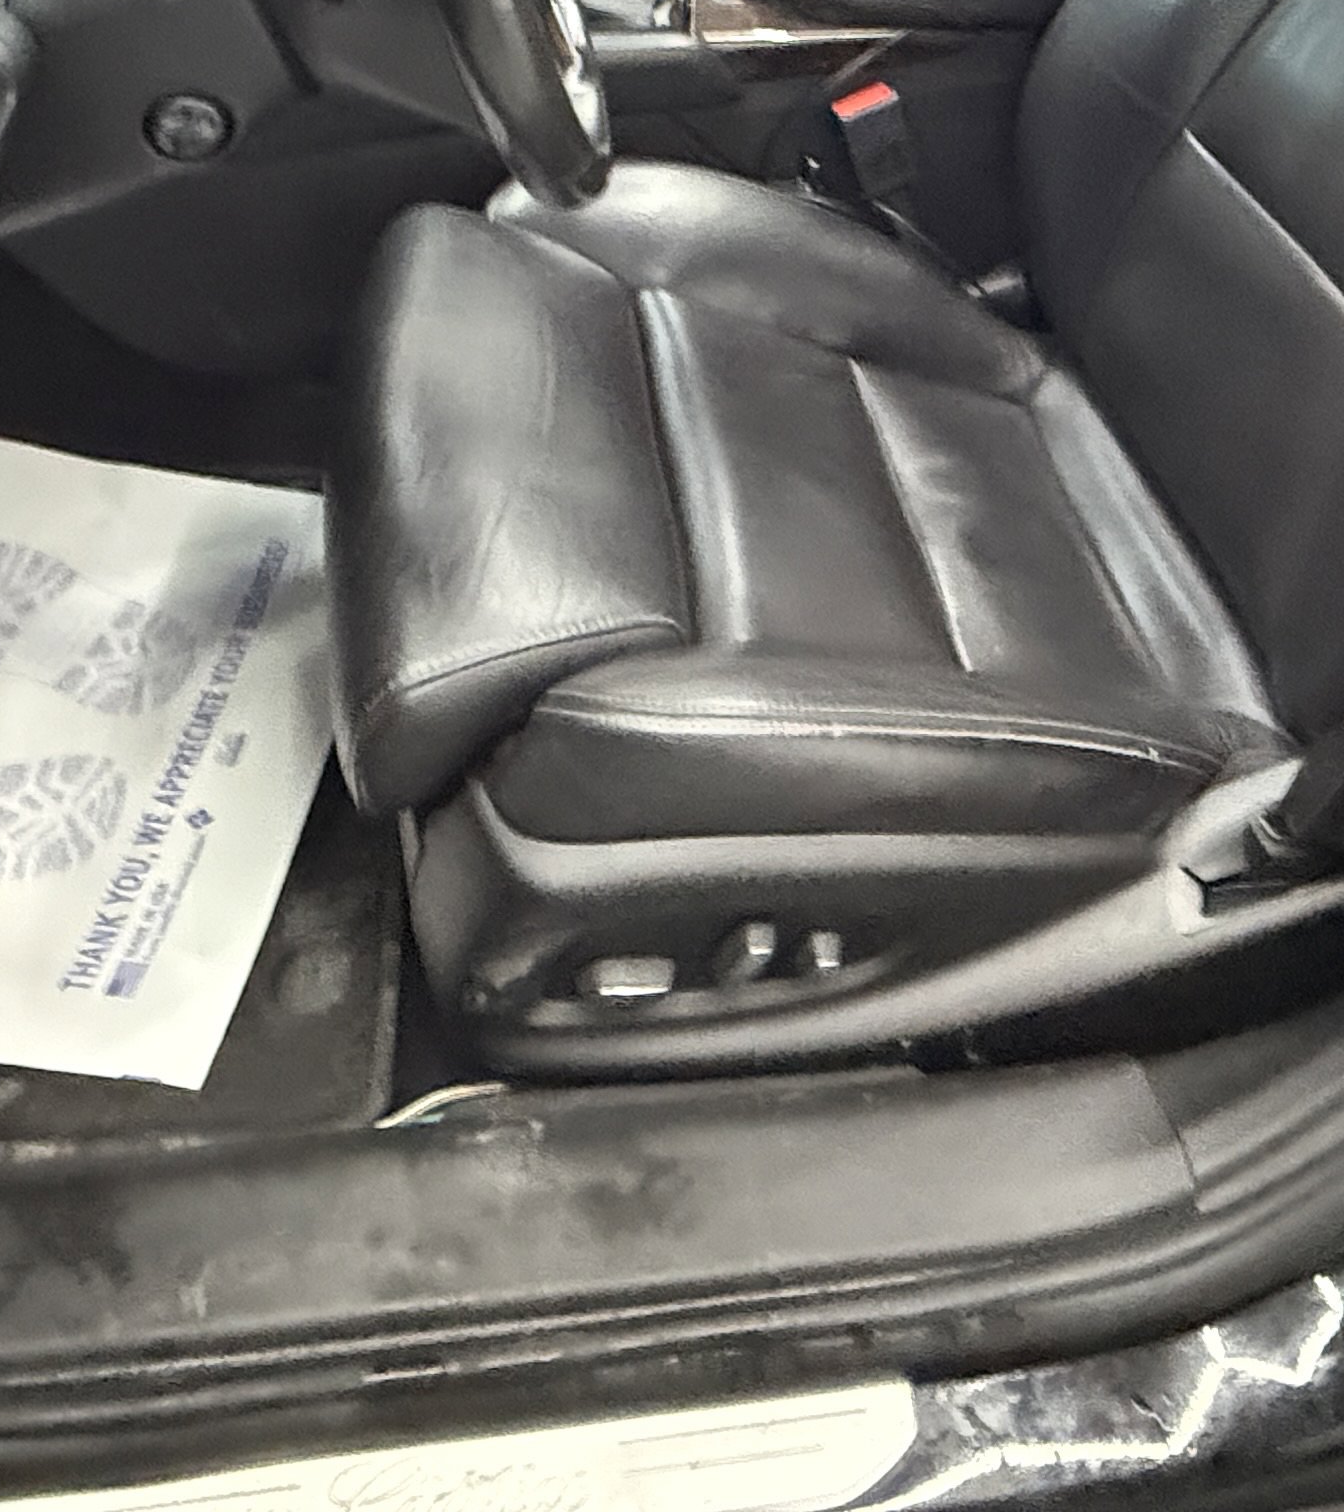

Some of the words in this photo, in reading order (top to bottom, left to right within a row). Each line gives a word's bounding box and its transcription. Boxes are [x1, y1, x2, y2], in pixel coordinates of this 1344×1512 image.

[153, 689, 230, 809] APPRECIATE
[132, 810, 176, 846] WE
[101, 851, 161, 905] YOU,
[57, 908, 129, 992] THANK
